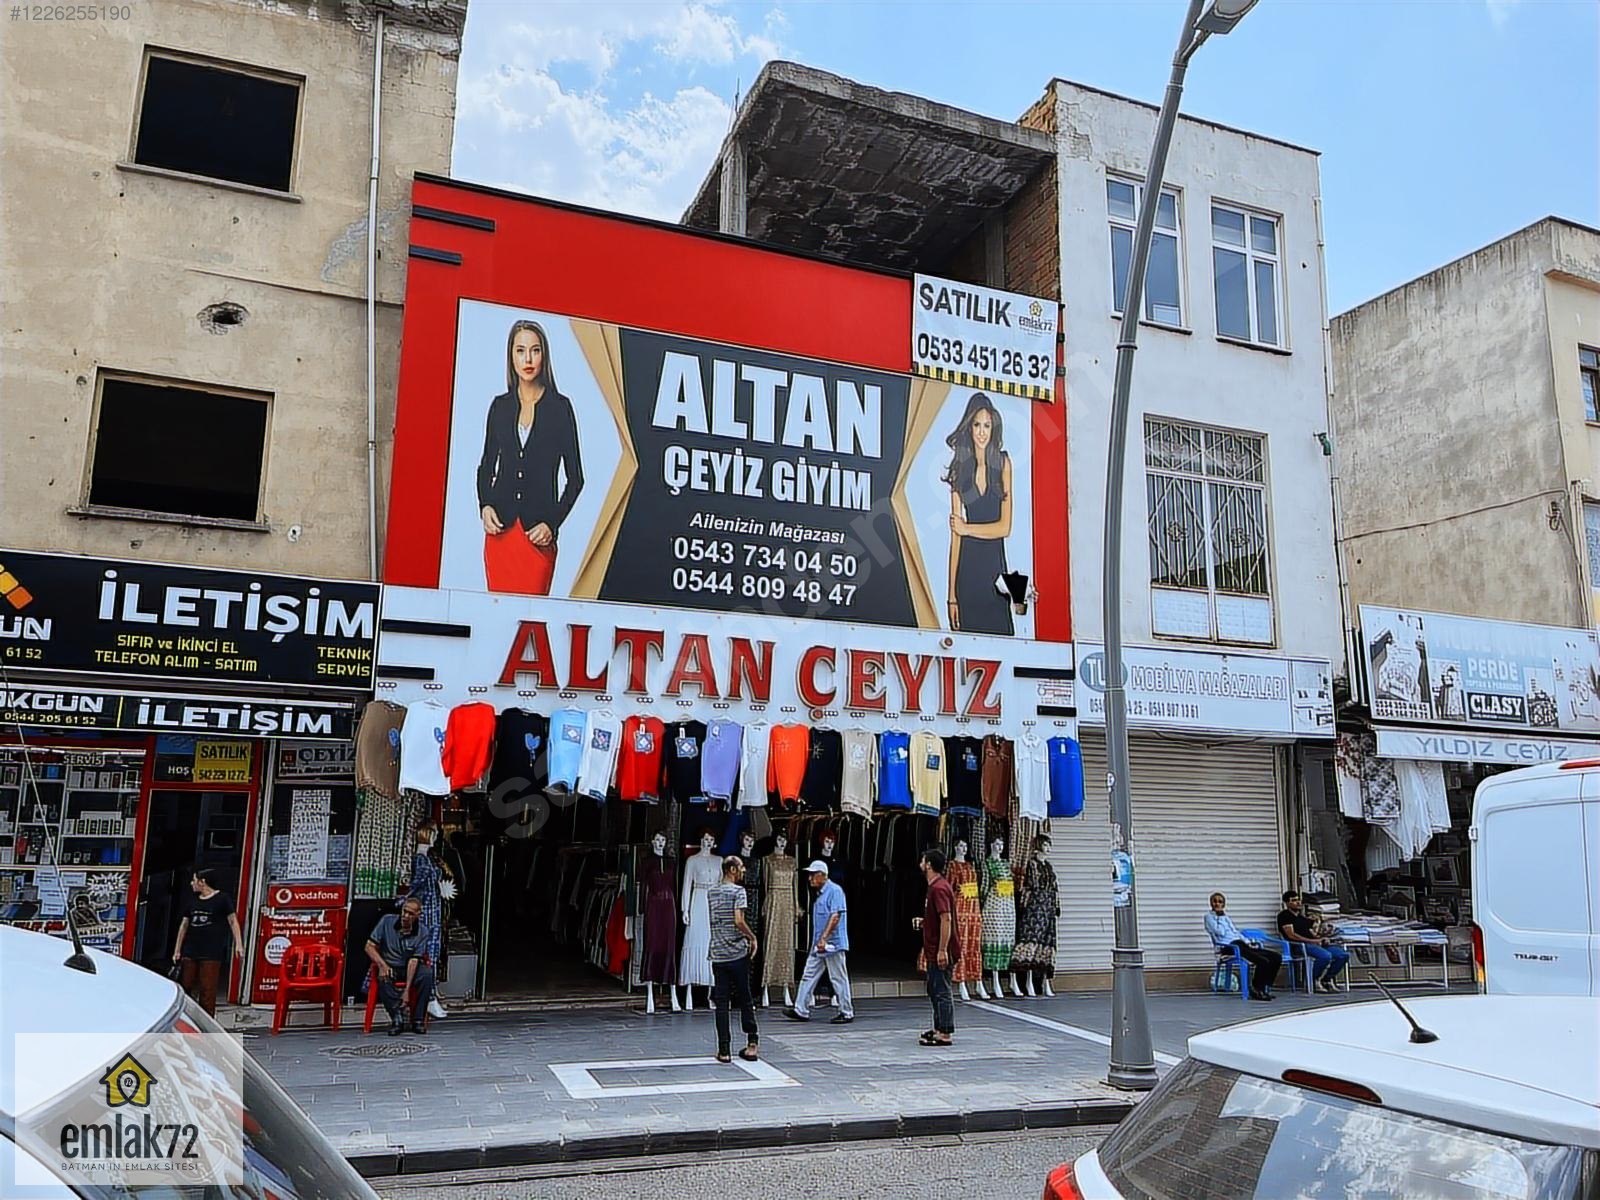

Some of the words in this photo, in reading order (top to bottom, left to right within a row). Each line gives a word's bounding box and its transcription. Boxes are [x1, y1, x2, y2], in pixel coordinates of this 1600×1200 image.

[919, 282, 1011, 327] SATILIK
[917, 333, 963, 365] 0533
[968, 344, 997, 372] 451
[1001, 349, 1023, 377] 26
[1028, 355, 1051, 380] 32
[652, 351, 882, 459] ALTAN
[664, 445, 765, 498] ÇEYİZ
[772, 456, 872, 511] GİYİM
[690, 512, 764, 535] Ailenizin
[769, 521, 845, 544] Mağazası
[674, 537, 734, 565] 0543
[743, 544, 787, 570] 734
[794, 551, 823, 573] 04
[830, 554, 857, 577] 50
[673, 568, 734, 595] 0544
[742, 575, 786, 600] 809
[793, 580, 821, 603] 48
[829, 583, 857, 606] 47
[99, 569, 374, 642] İLETİŞİM
[6, 647, 21, 658] 61
[25, 648, 42, 659] 52
[117, 634, 154, 648] SIFIR
[158, 639, 173, 649] ve
[177, 635, 218, 652] İKİNCİ
[222, 641, 239, 654] EL
[317, 646, 372, 660] TEKNİK
[94, 649, 160, 665] TELEFON
[164, 655, 199, 668] ALIM
[214, 658, 258, 672] SATIM
[317, 663, 370, 677] SERVİS
[494, 619, 777, 703] ALTAN
[1467, 657, 1519, 681] PERDE
[795, 637, 1003, 721] ÇEYİZ
[1131, 662, 1197, 694] MOBİLYA
[1199, 667, 1288, 700] MAĞAZALARI
[137, 698, 332, 736] İLETİŞİM
[1134, 701, 1143, 715] 25
[1470, 694, 1521, 716] CLASY
[4, 712, 34, 722] 0544
[40, 714, 61, 723] 205
[65, 716, 78, 724] 61
[82, 716, 97, 725] 52
[201, 744, 247, 759] SATILIK
[1416, 736, 1494, 757] YILDIZ
[1504, 740, 1569, 762] ÇEYİZ
[167, 765, 190, 776] HOŞ
[294, 890, 339, 900] vodafone
